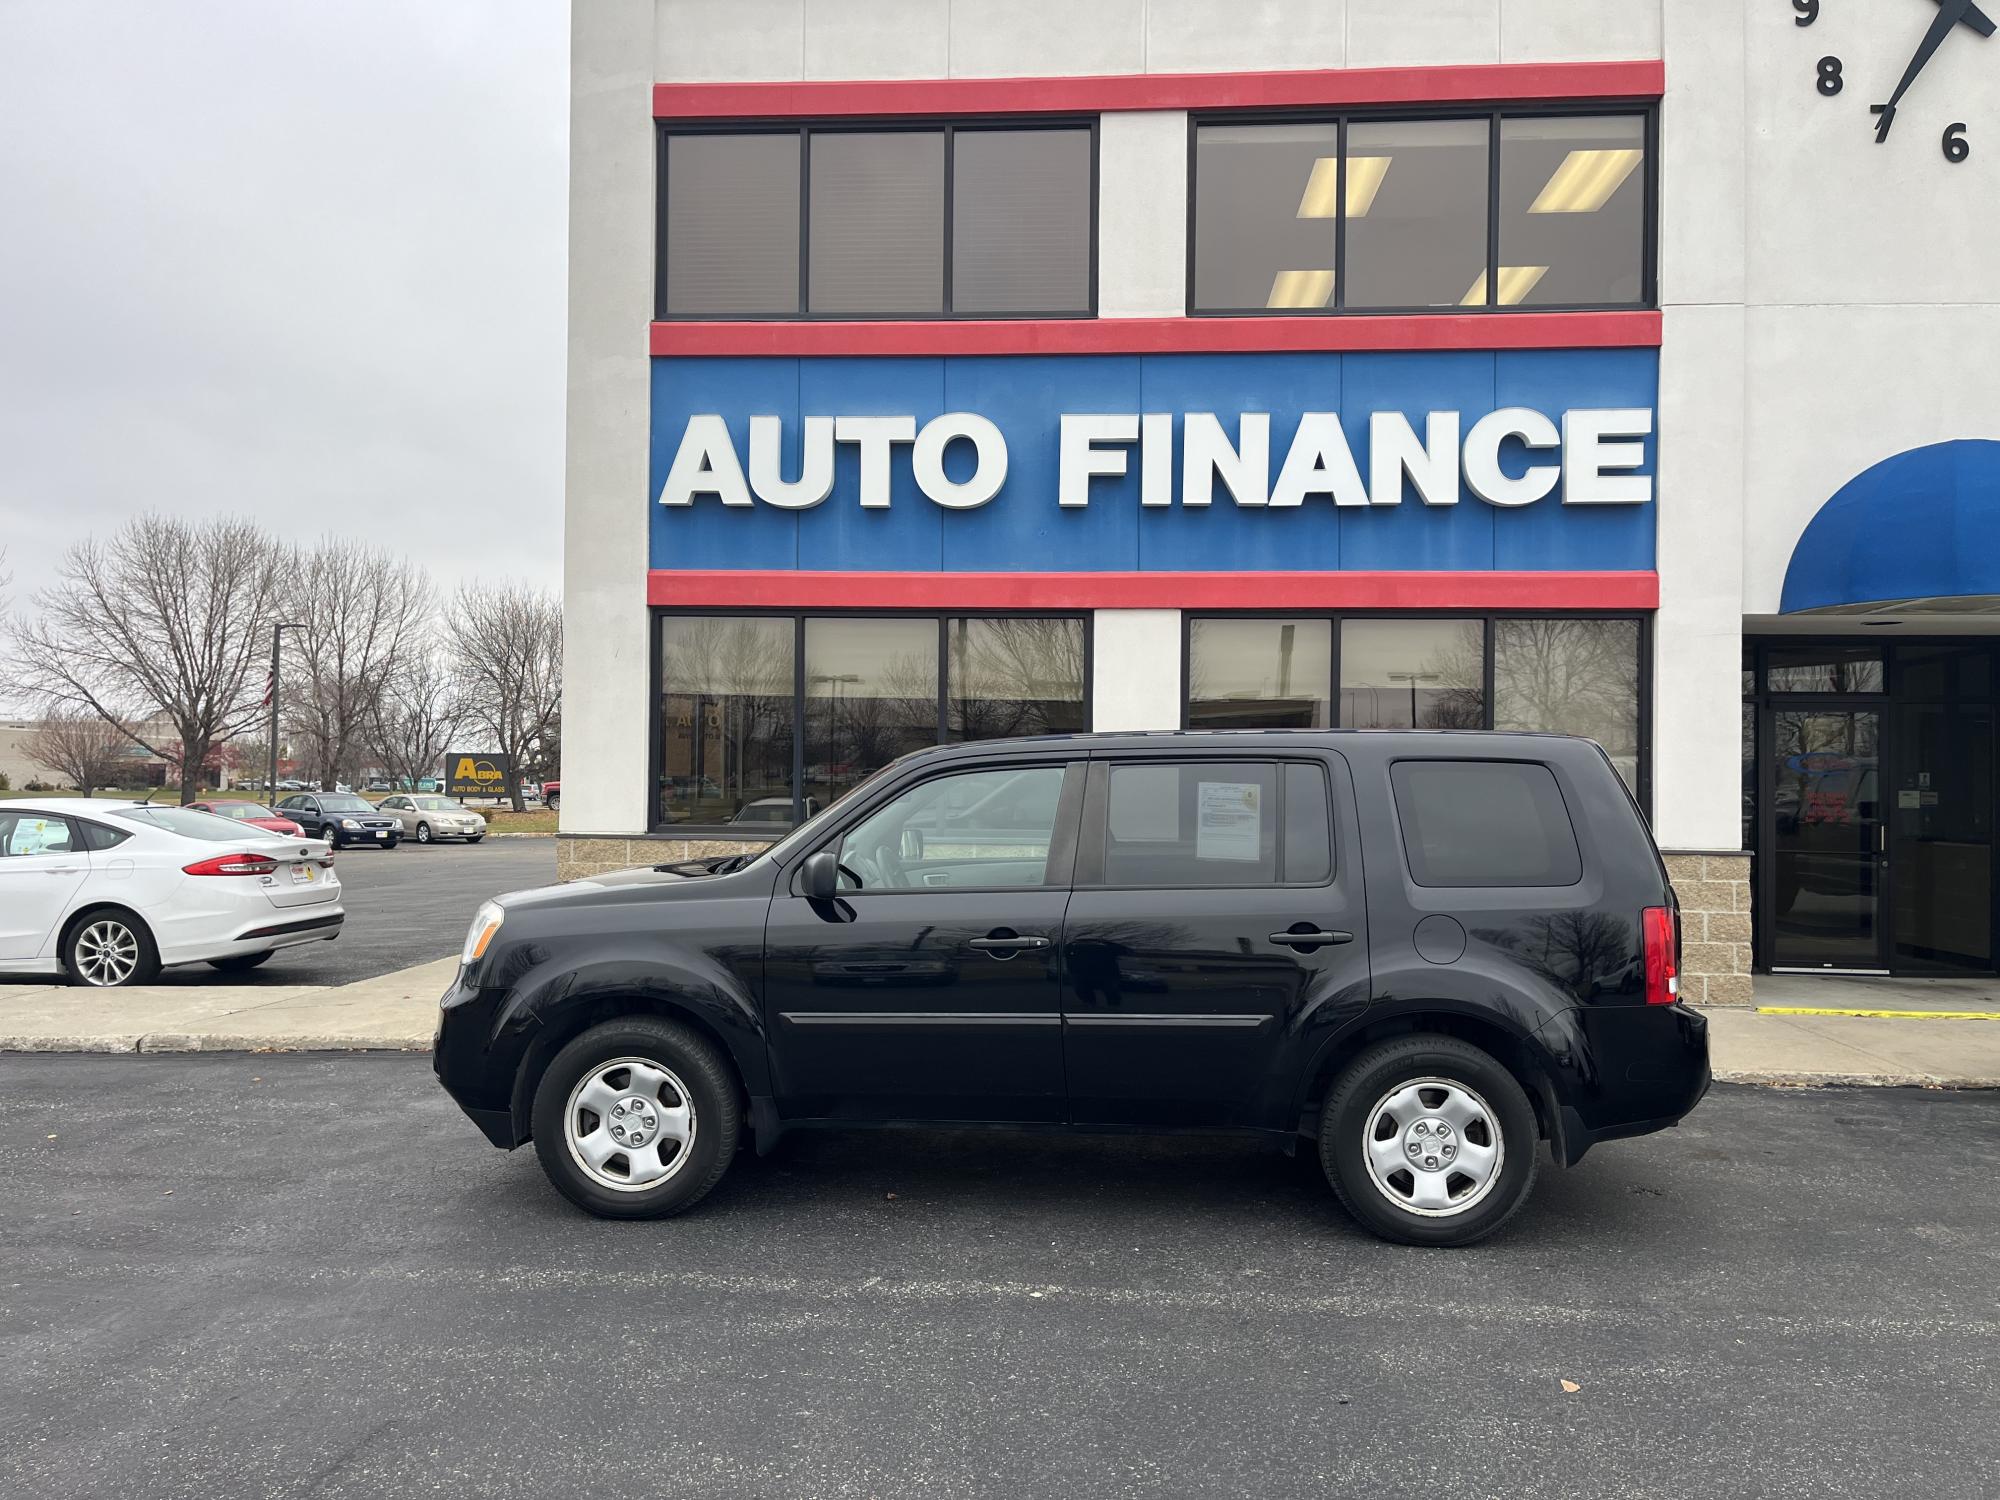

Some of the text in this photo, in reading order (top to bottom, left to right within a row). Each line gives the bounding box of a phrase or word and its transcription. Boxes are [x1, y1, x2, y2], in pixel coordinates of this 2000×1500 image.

[1791, 0, 1819, 27] 9
[1816, 56, 1843, 97] 8
[1942, 122, 1970, 163] 6
[659, 406, 1652, 510] AUTO FINANCE
[454, 757, 503, 780] ABRA
[452, 785, 466, 793] AUTO
[466, 785, 480, 793] BODY
[487, 785, 505, 793] GLASS
